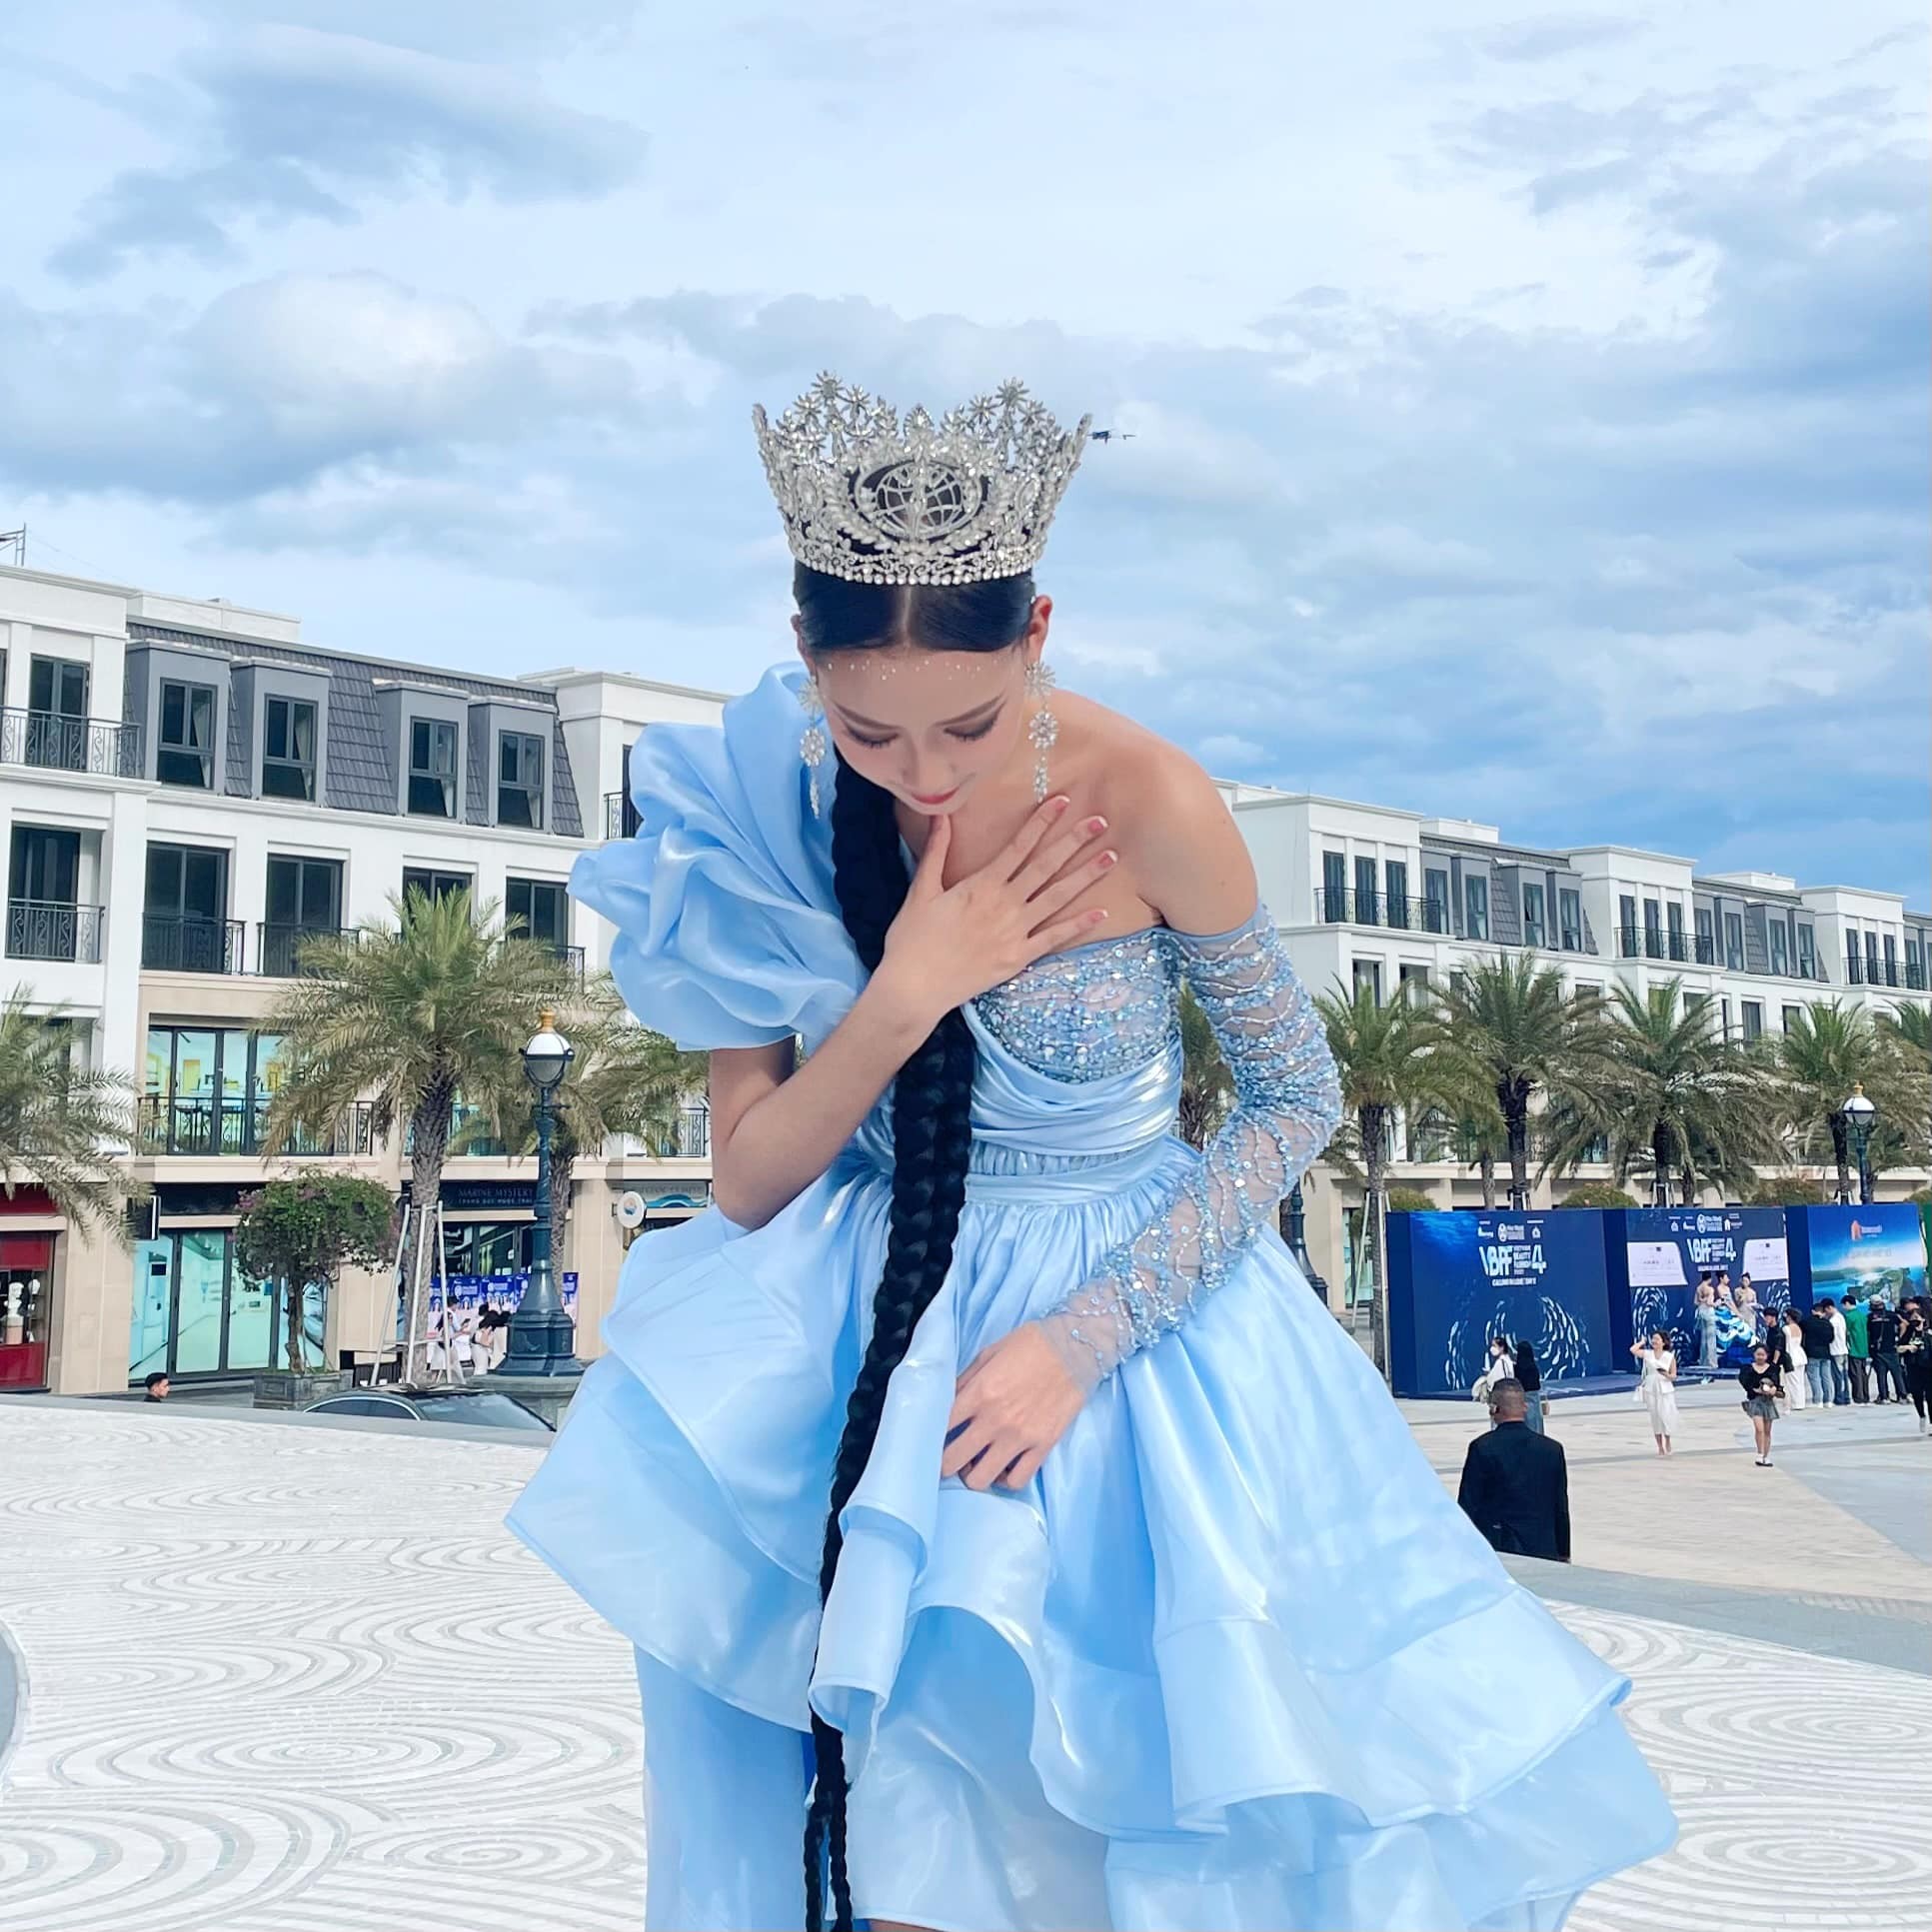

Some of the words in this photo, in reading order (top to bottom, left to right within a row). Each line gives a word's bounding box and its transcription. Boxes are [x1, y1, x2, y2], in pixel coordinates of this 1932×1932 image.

[458, 1187, 495, 1197] MARINE
[496, 1187, 533, 1197] MYSTERY
[1531, 1244, 1547, 1274] 4
[1725, 1237, 1737, 1261] 4
